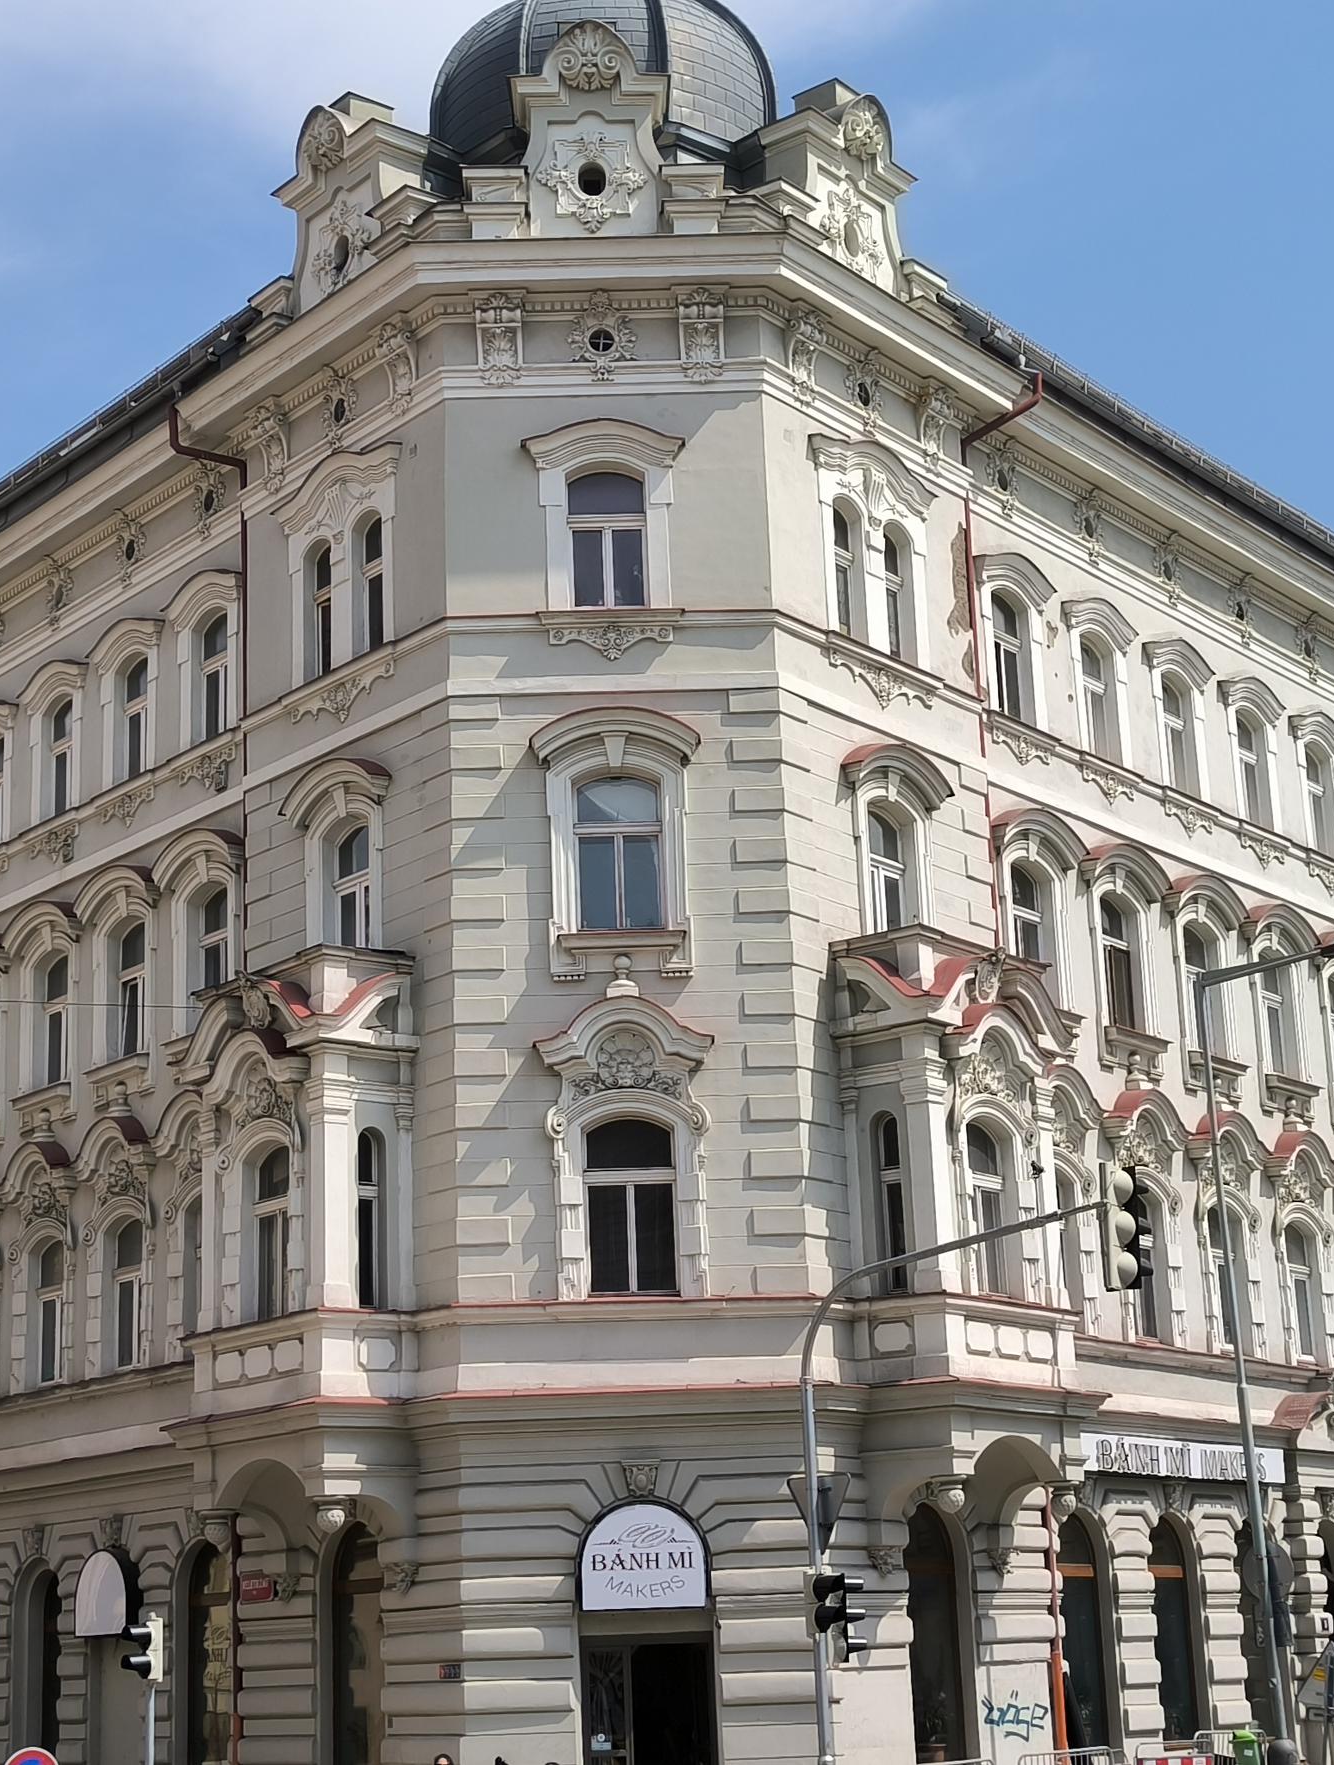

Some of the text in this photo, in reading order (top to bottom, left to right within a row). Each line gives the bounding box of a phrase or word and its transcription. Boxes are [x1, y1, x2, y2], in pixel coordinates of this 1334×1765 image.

[1096, 1437, 1161, 1474] BÁNH
[1200, 1449, 1267, 1481] MAKES
[591, 1548, 662, 1571] BÁNH
[605, 1575, 685, 1598] MAKERS
